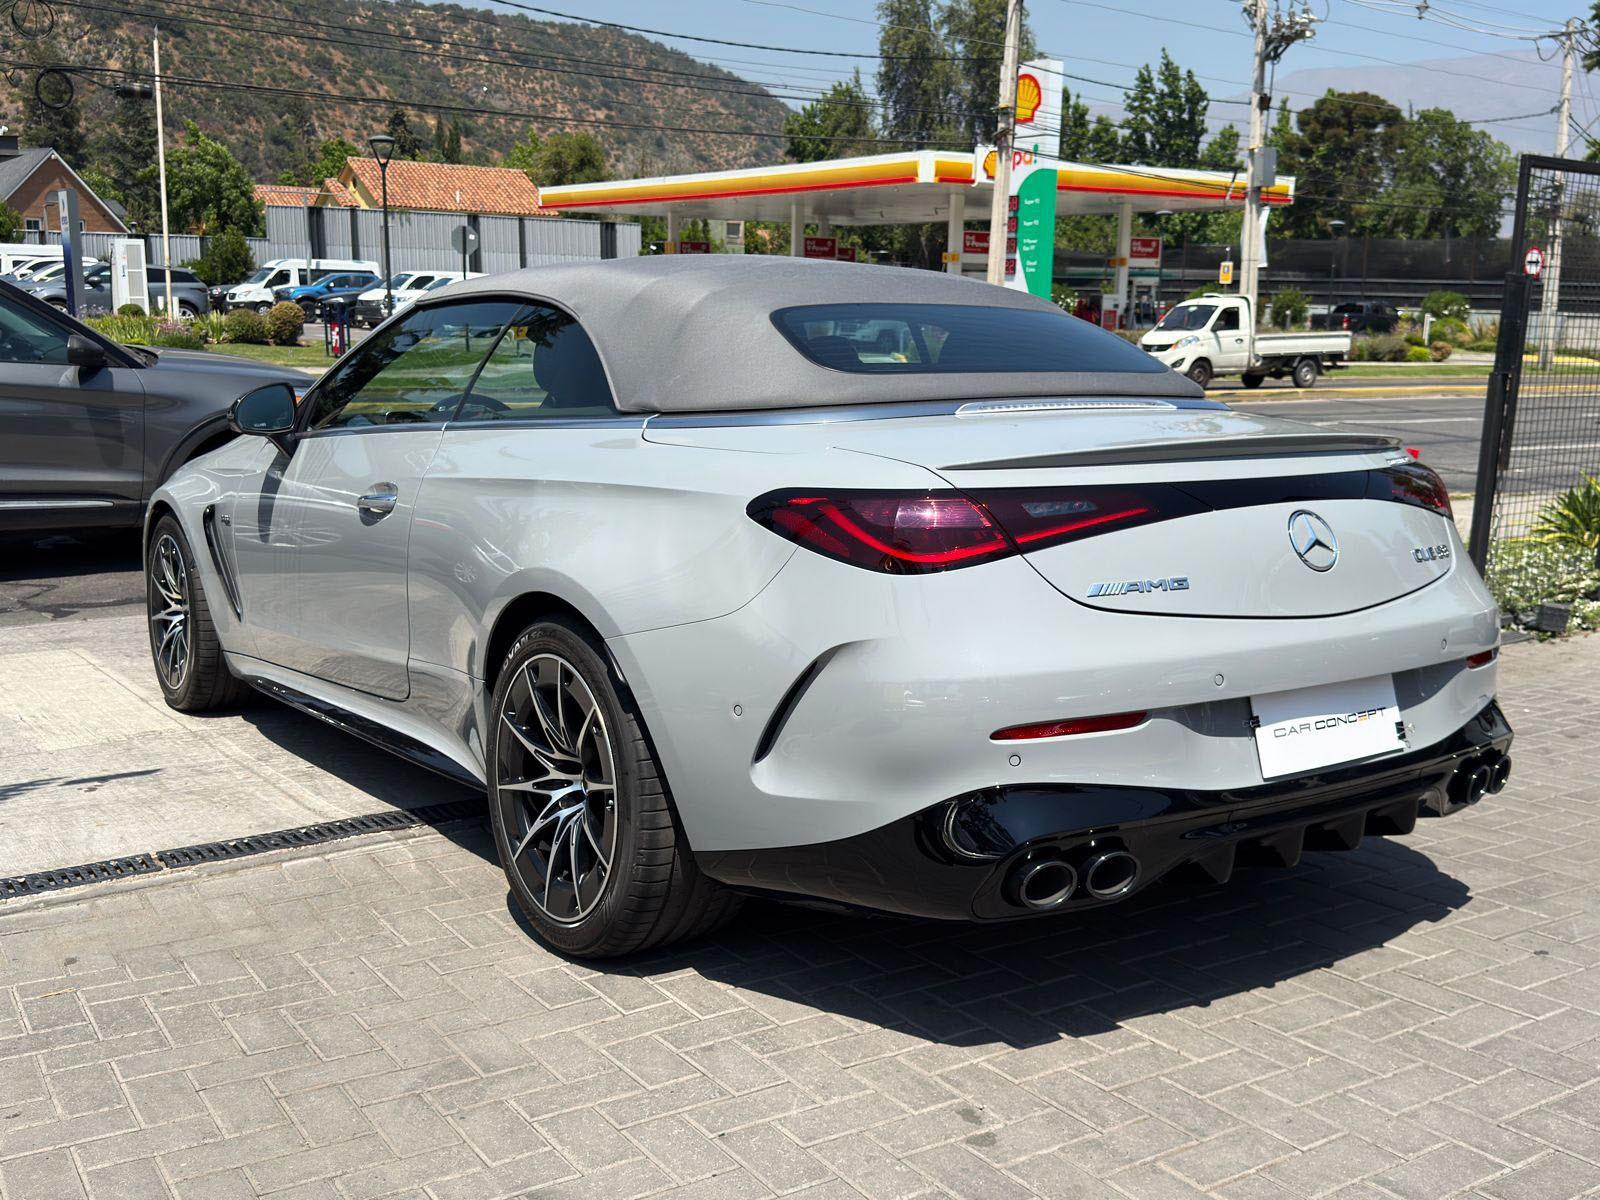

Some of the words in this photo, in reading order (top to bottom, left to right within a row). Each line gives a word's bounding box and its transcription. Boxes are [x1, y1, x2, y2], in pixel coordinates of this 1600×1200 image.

[1121, 576, 1190, 594] AMG
[1273, 723, 1311, 738] CAR
[1314, 706, 1387, 731] CONCEPT
